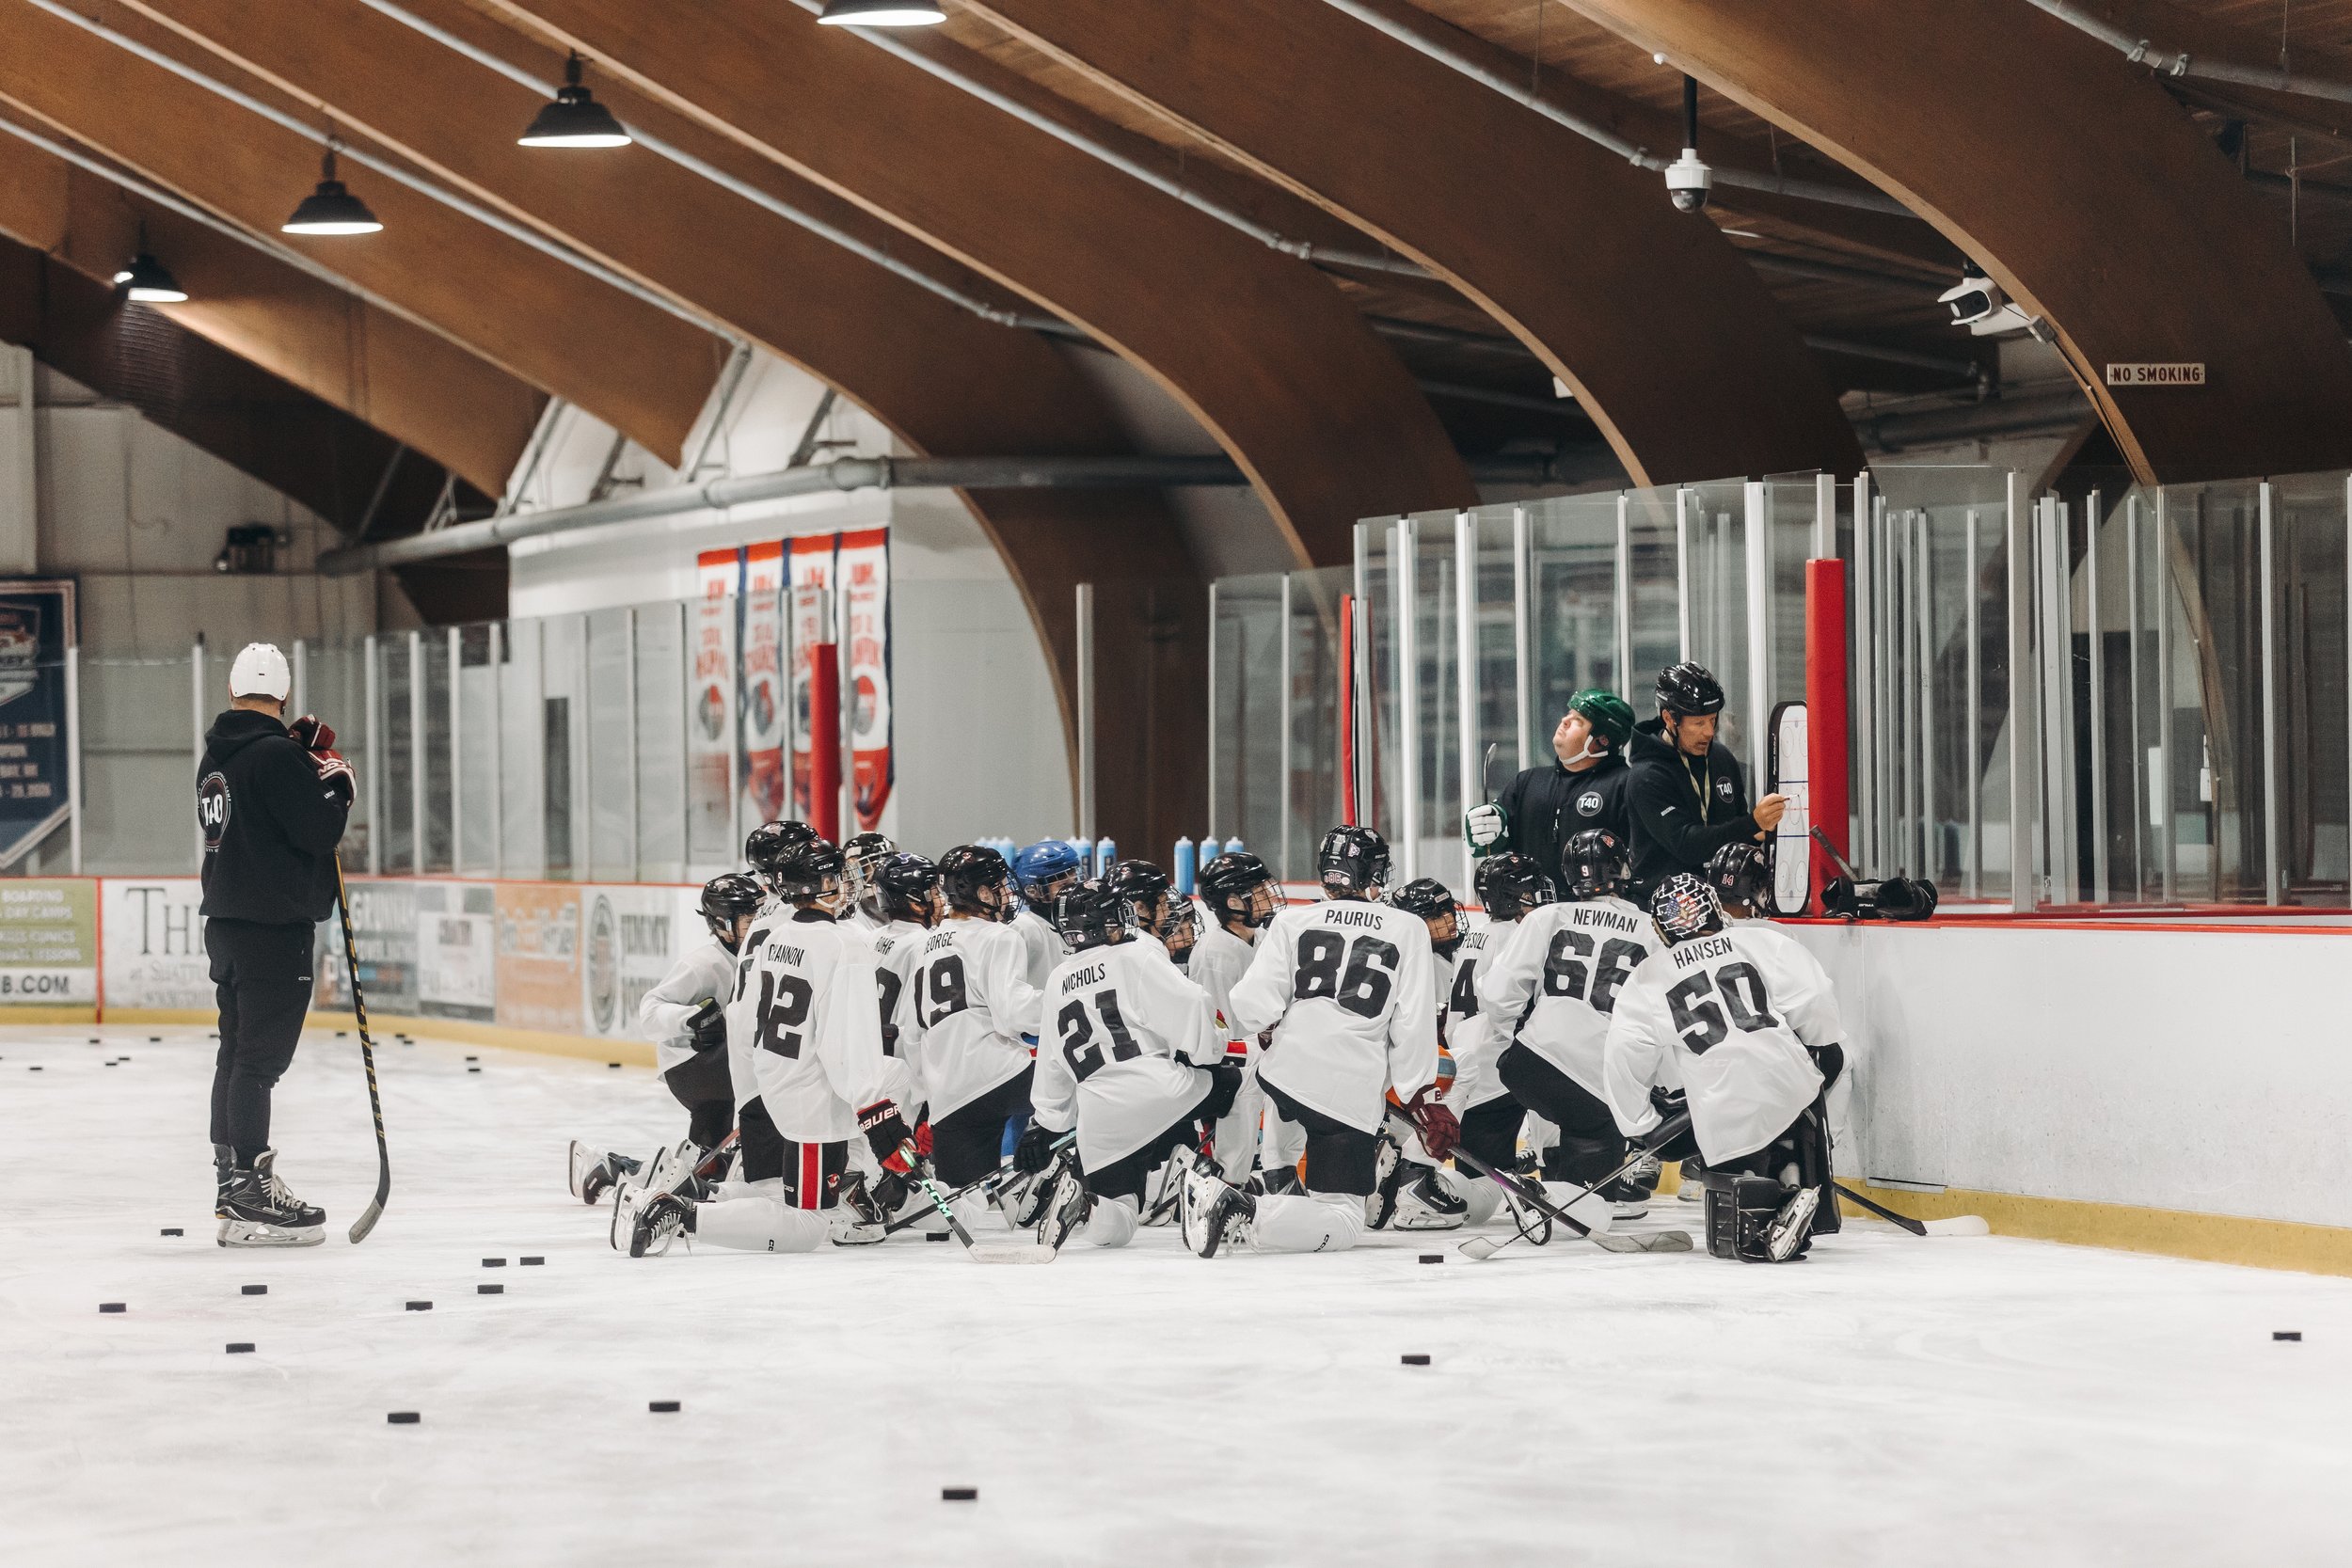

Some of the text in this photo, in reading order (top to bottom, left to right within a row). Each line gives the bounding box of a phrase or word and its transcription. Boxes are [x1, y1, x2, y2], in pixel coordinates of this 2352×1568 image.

[2113, 367, 2201, 382] NO SMOKING
[1717, 782, 1733, 796] T40
[1580, 797, 1599, 809] T40
[818, 863, 834, 871] CCM
[1327, 871, 1343, 884] 86
[1581, 865, 1590, 877] 9
[1722, 873, 1734, 887] 14
[1325, 910, 1383, 930] PAURUS
[1573, 908, 1638, 934] NEWMAN
[1673, 937, 1734, 970] HANSEN
[1062, 962, 1106, 996] NICHOLS
[1295, 929, 1400, 1020] 86
[1544, 929, 1649, 1014] 66
[1450, 958, 1480, 1020] 4
[1665, 961, 1780, 1056] 50
[1057, 989, 1143, 1084] 21
[922, 1179, 954, 1218] CCM
